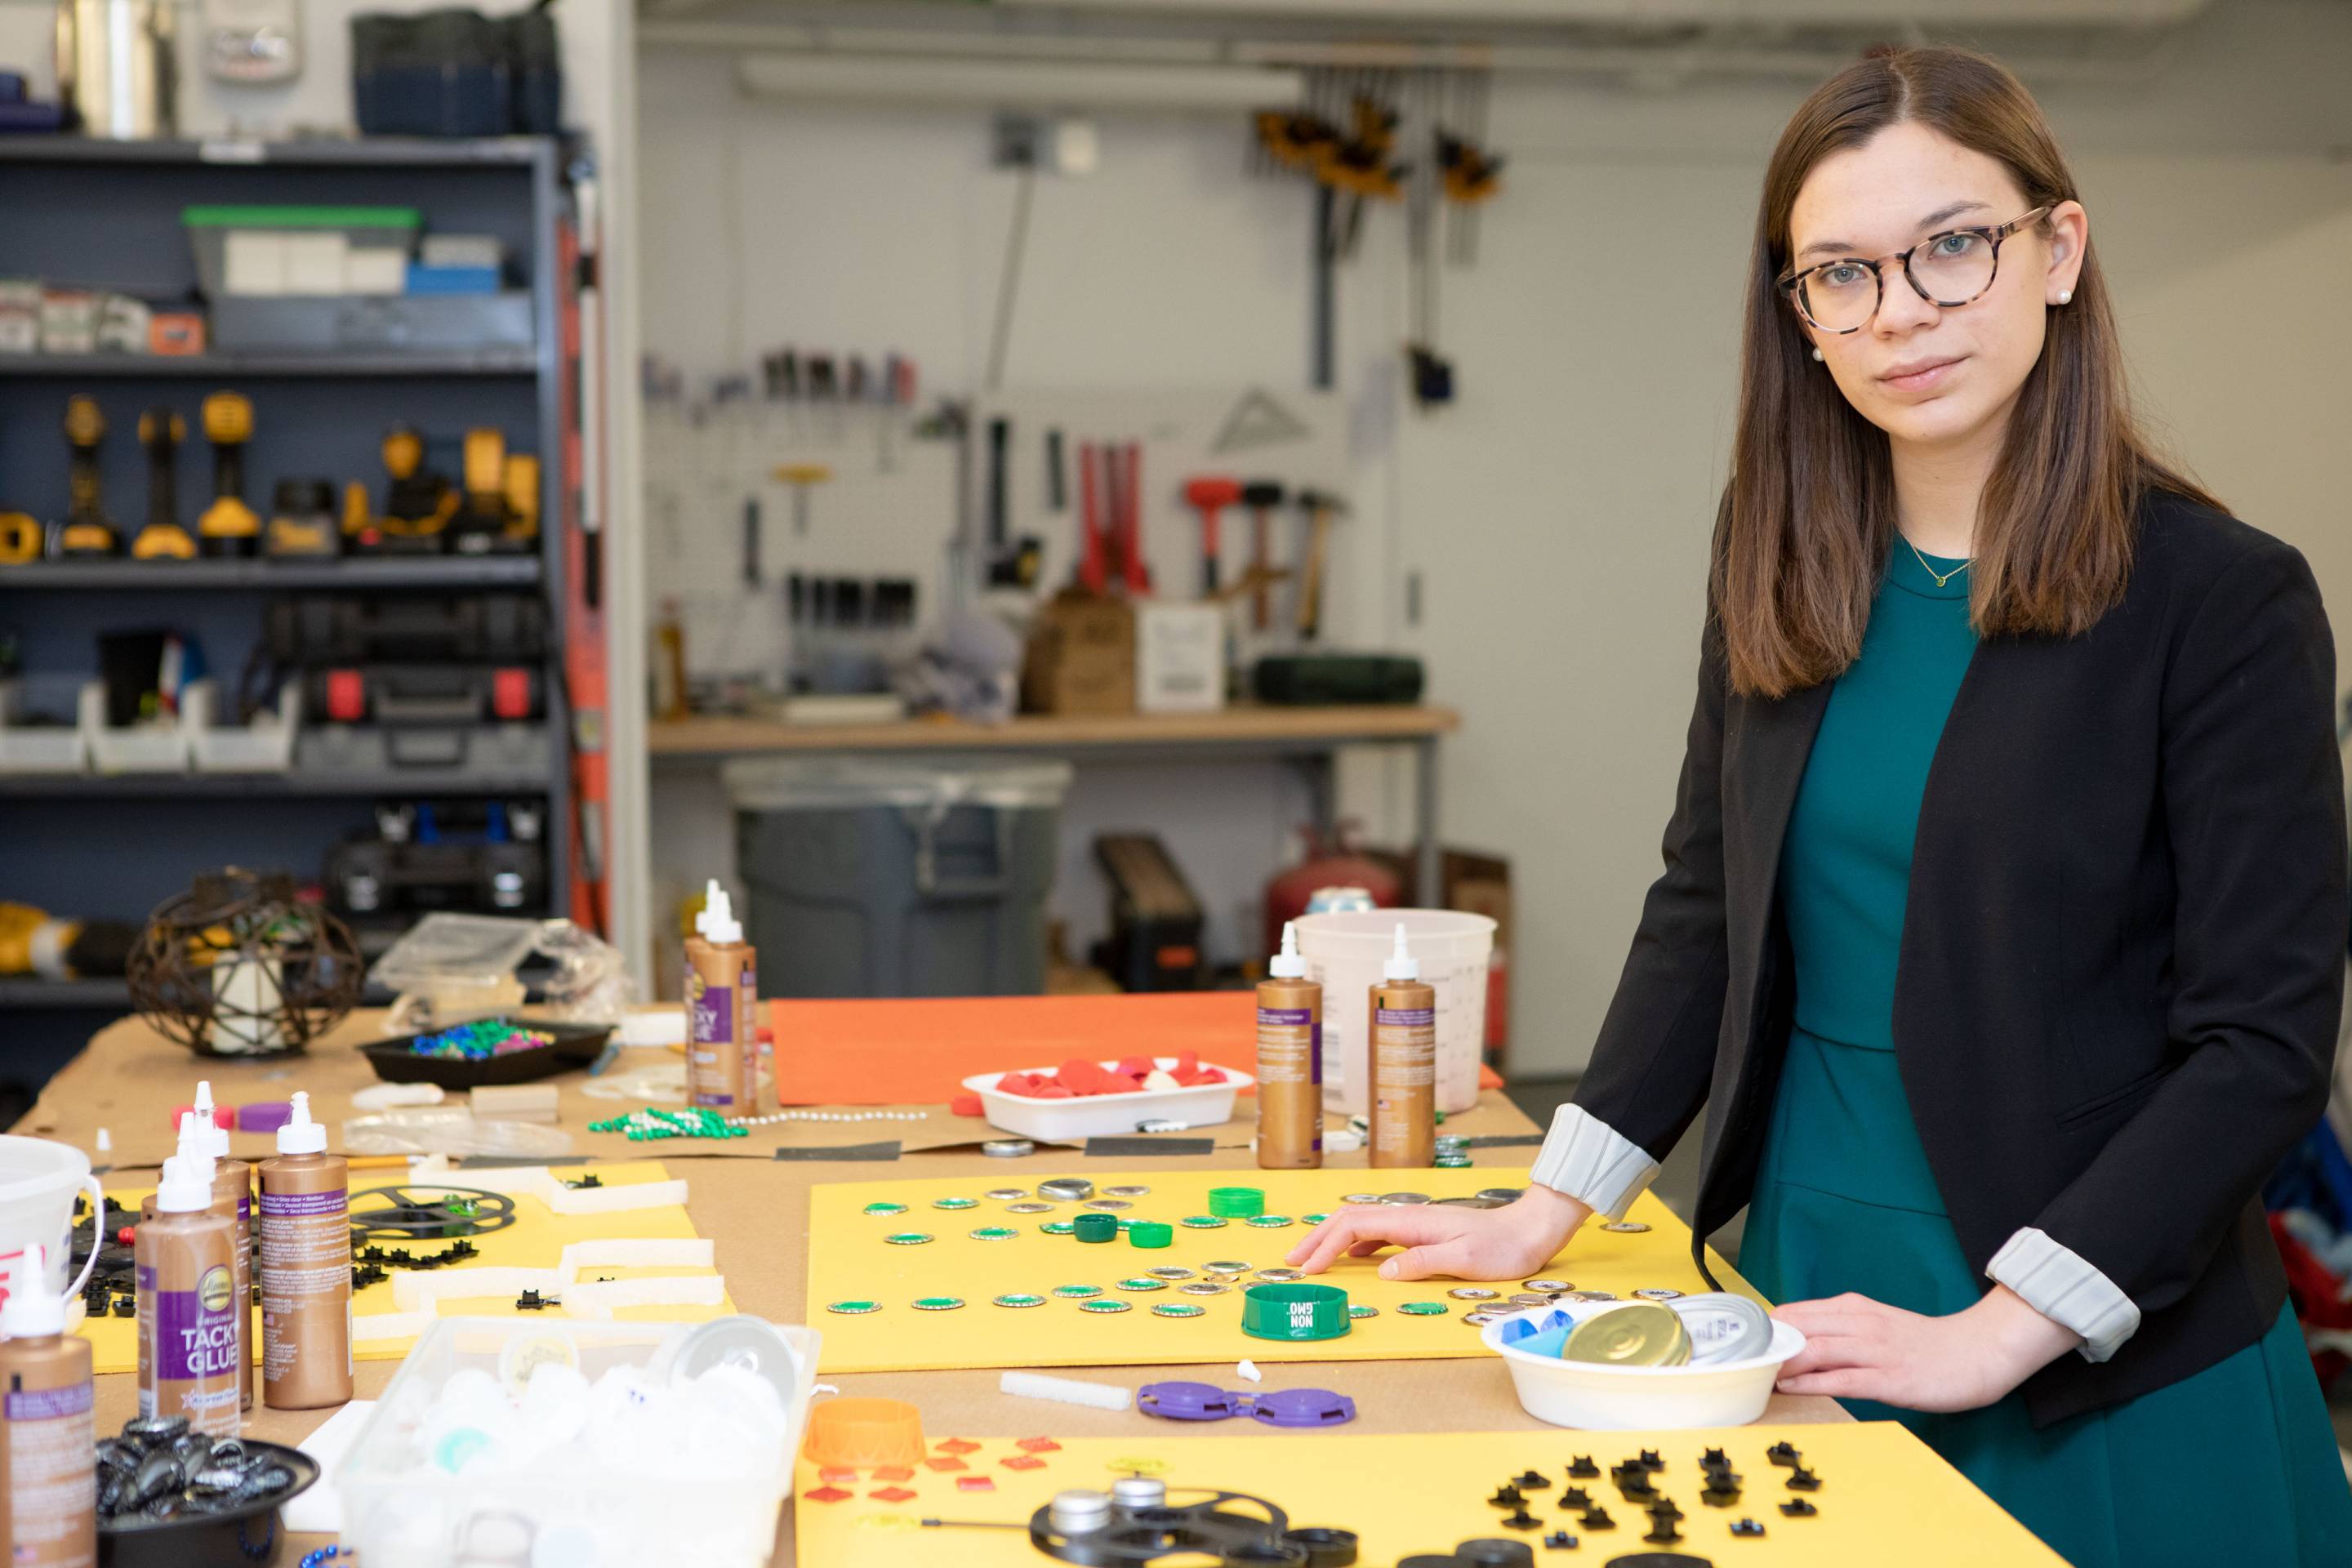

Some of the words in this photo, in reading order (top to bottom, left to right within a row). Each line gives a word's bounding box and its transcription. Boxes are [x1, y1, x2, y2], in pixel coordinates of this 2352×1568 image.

[1290, 1302, 1313, 1315] GMO
[1290, 1315, 1313, 1328] NON
[186, 1343, 238, 1374] GLUE
